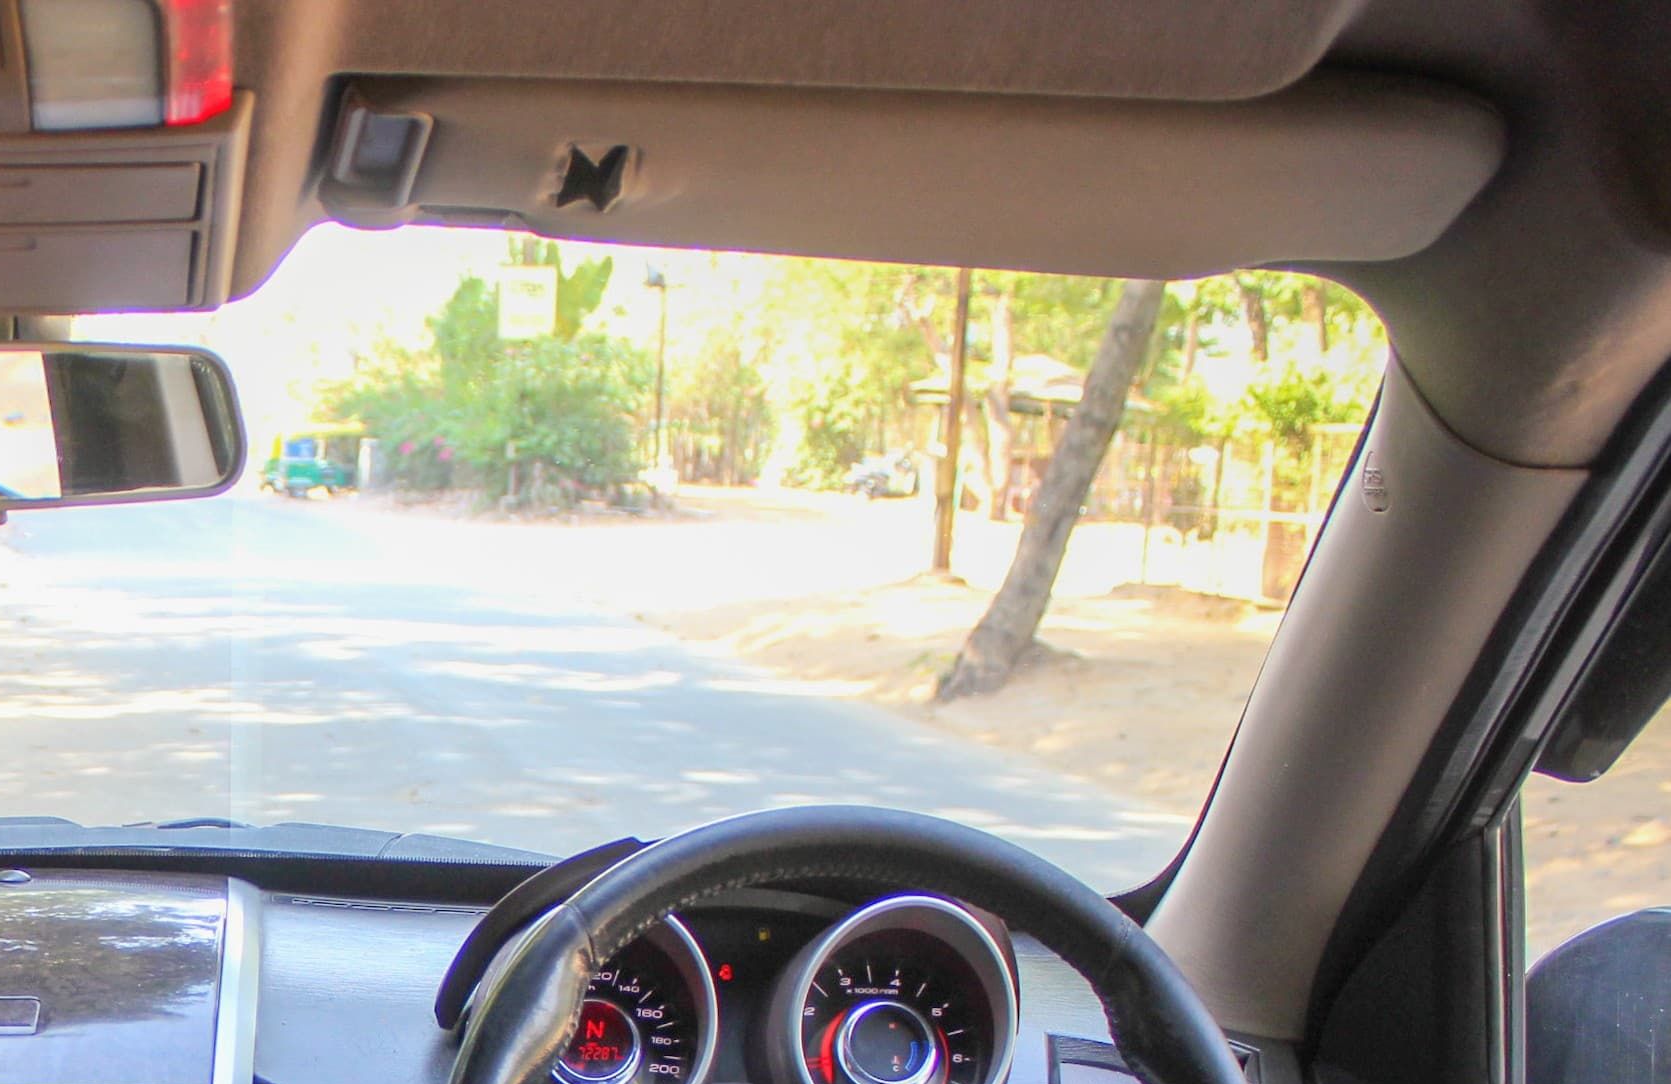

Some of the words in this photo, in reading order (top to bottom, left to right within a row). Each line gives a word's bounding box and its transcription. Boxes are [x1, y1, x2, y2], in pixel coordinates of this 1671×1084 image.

[592, 972, 613, 980] 20
[840, 977, 851, 986] 3
[890, 978, 901, 987] 4
[619, 984, 640, 993] 140
[636, 1008, 664, 1019] 160
[804, 1006, 815, 1016] 2
[932, 1007, 942, 1017] 5
[586, 1020, 605, 1038] N
[651, 1036, 672, 1045] 180
[952, 1054, 963, 1063] 6
[649, 1064, 680, 1075] 200
